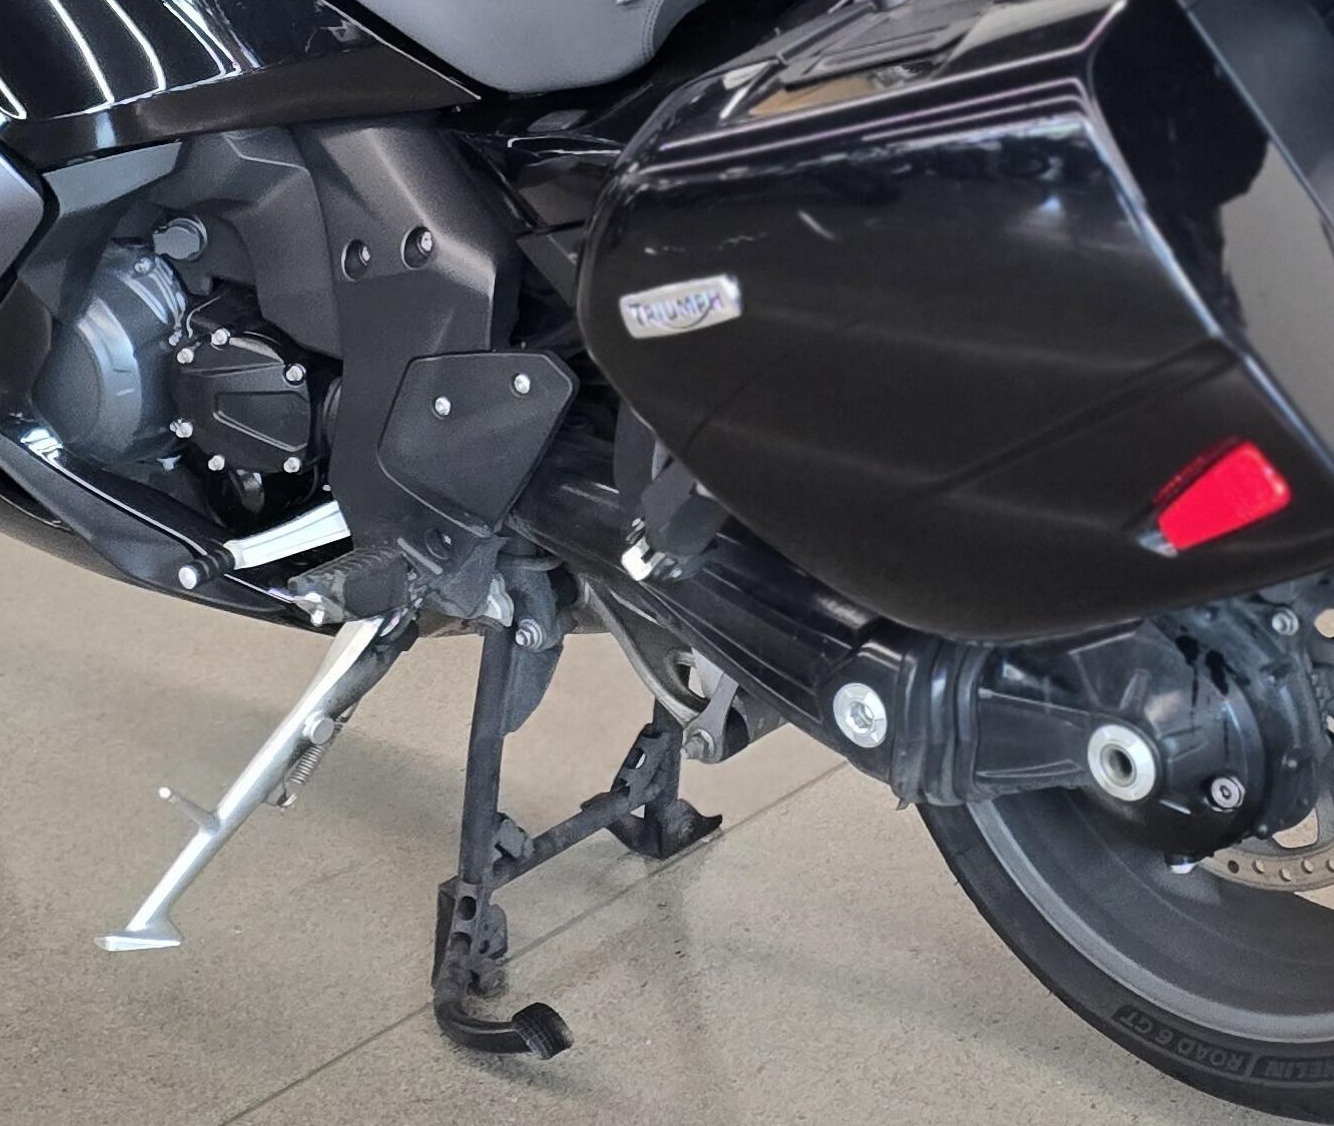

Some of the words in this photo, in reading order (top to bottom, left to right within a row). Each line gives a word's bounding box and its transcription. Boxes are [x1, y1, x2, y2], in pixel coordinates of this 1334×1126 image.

[629, 293, 724, 327] TRIUMPH
[1119, 1011, 1153, 1036] GT
[1154, 1030, 1174, 1046] 6
[1178, 1038, 1244, 1072] ROAD
